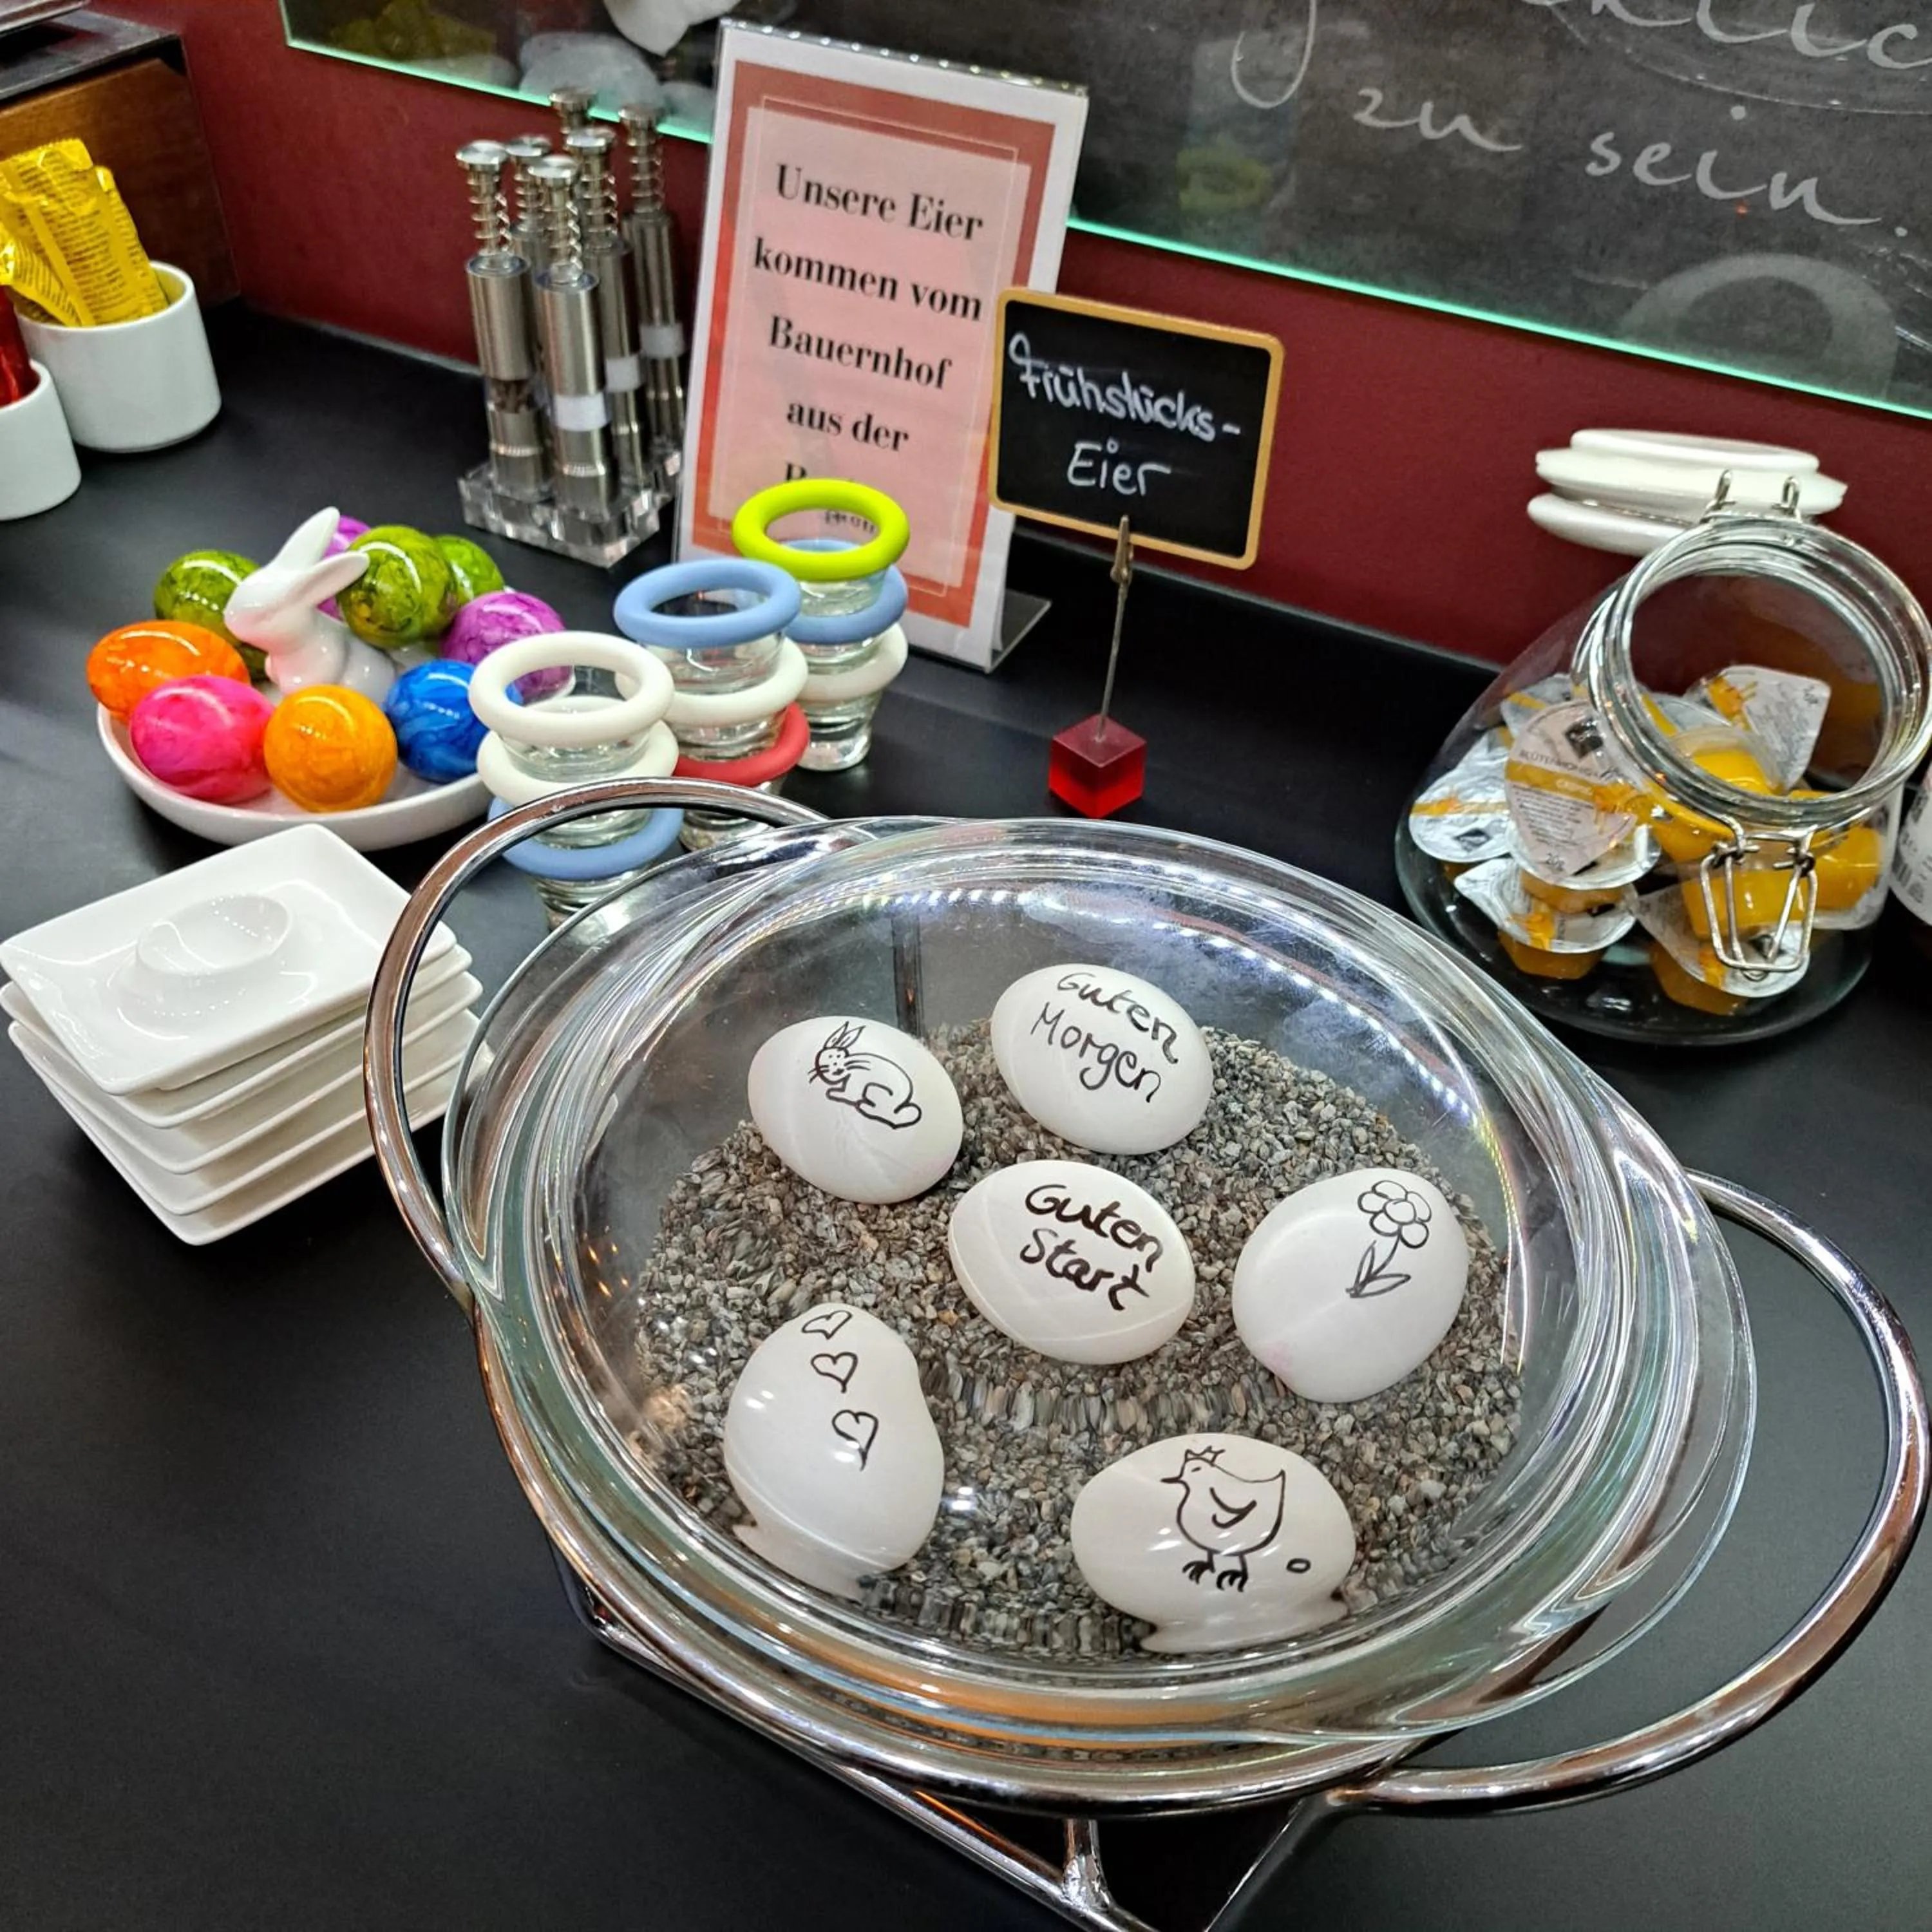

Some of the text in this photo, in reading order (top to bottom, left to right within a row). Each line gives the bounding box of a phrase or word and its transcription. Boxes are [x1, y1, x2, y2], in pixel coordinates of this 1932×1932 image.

[775, 162, 984, 242] Unsere Eier
[1353, 88, 1909, 238] zu sein.
[753, 236, 982, 322] kommen vom
[768, 314, 952, 390] Bauernhof
[786, 404, 909, 453] aus der
[1067, 437, 1172, 497] Eier
[1030, 1002, 1162, 1103] Morgen
[1057, 972, 1179, 1064] Guten
[1019, 1227, 1150, 1311] Start
[1025, 1184, 1164, 1273] Guten
